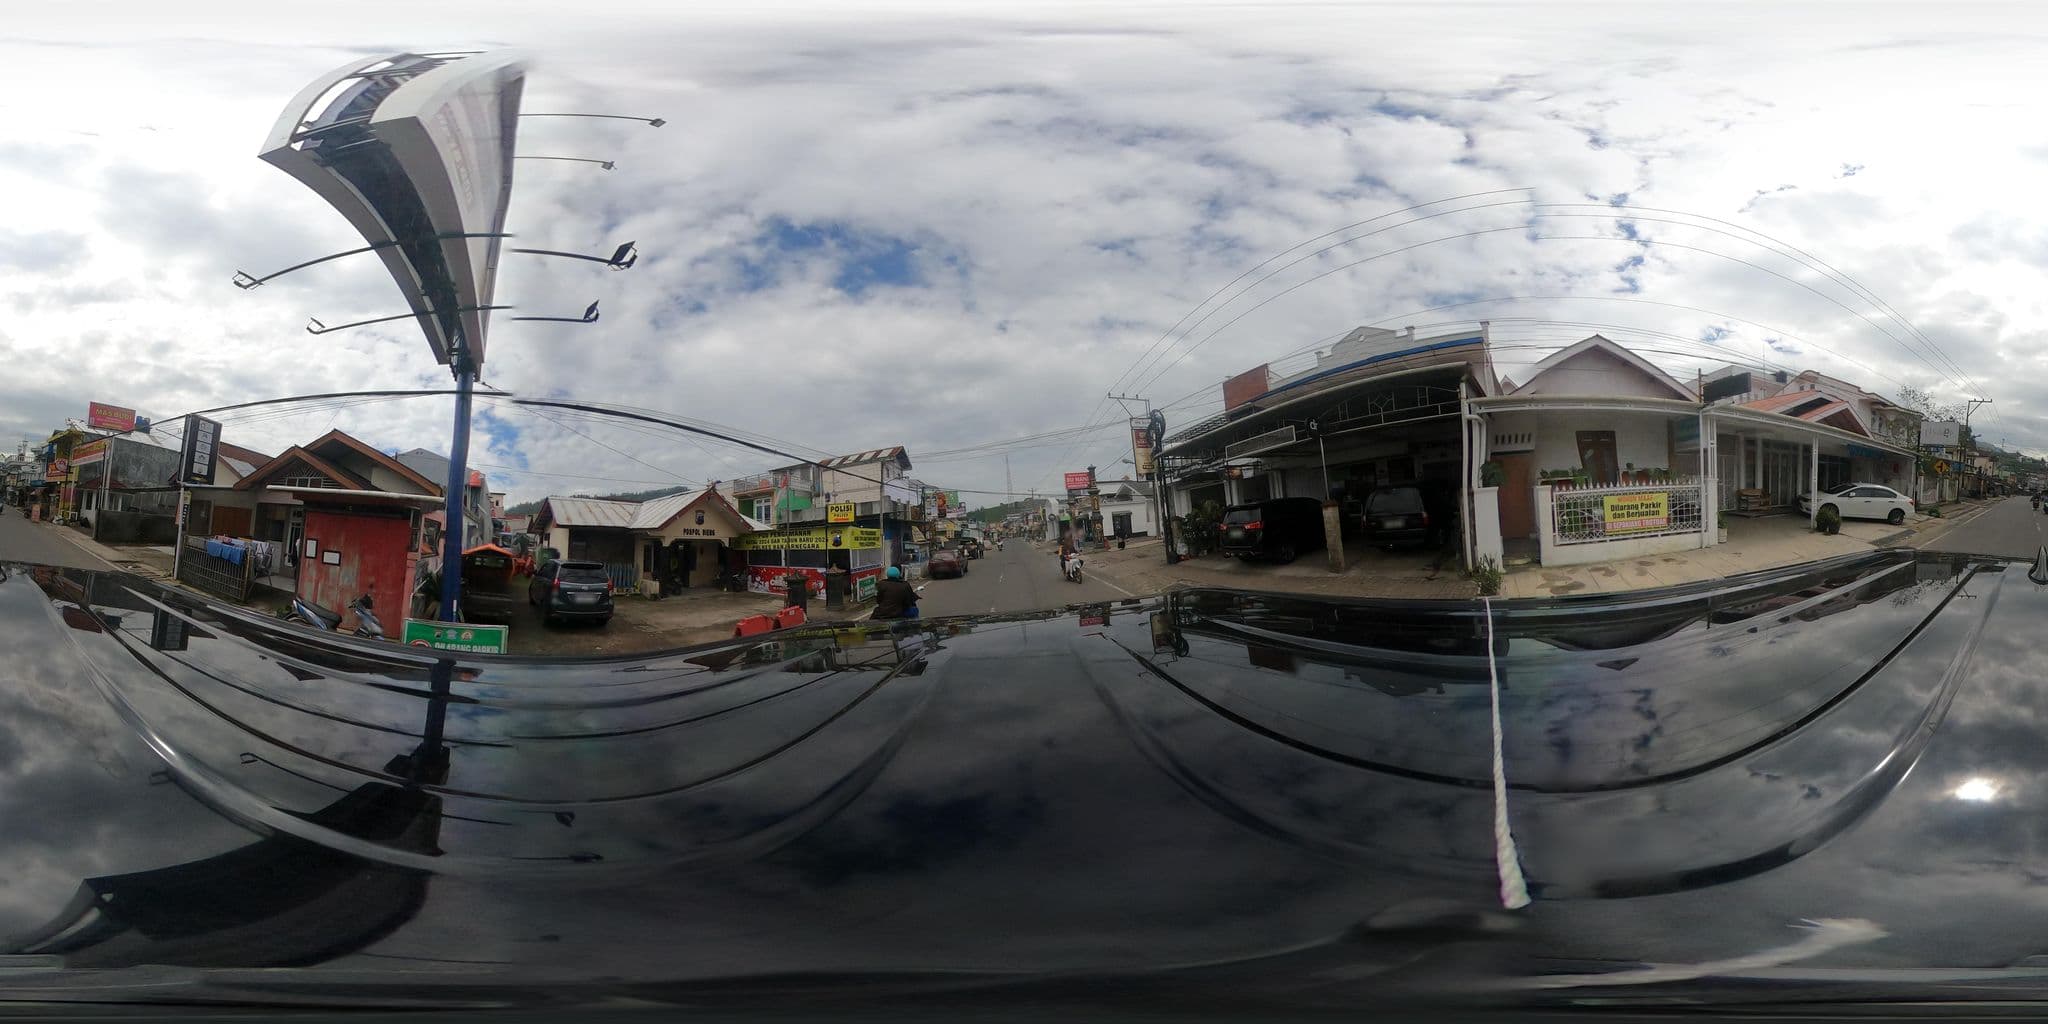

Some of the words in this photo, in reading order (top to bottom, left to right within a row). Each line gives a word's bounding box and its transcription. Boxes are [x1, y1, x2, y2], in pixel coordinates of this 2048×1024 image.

[96, 408, 113, 417] MAS
[830, 504, 852, 513] POLISI
[1627, 510, 1659, 518] Berjualan
[683, 528, 701, 536] POSPOL
[770, 530, 811, 538] PENGAMANAN
